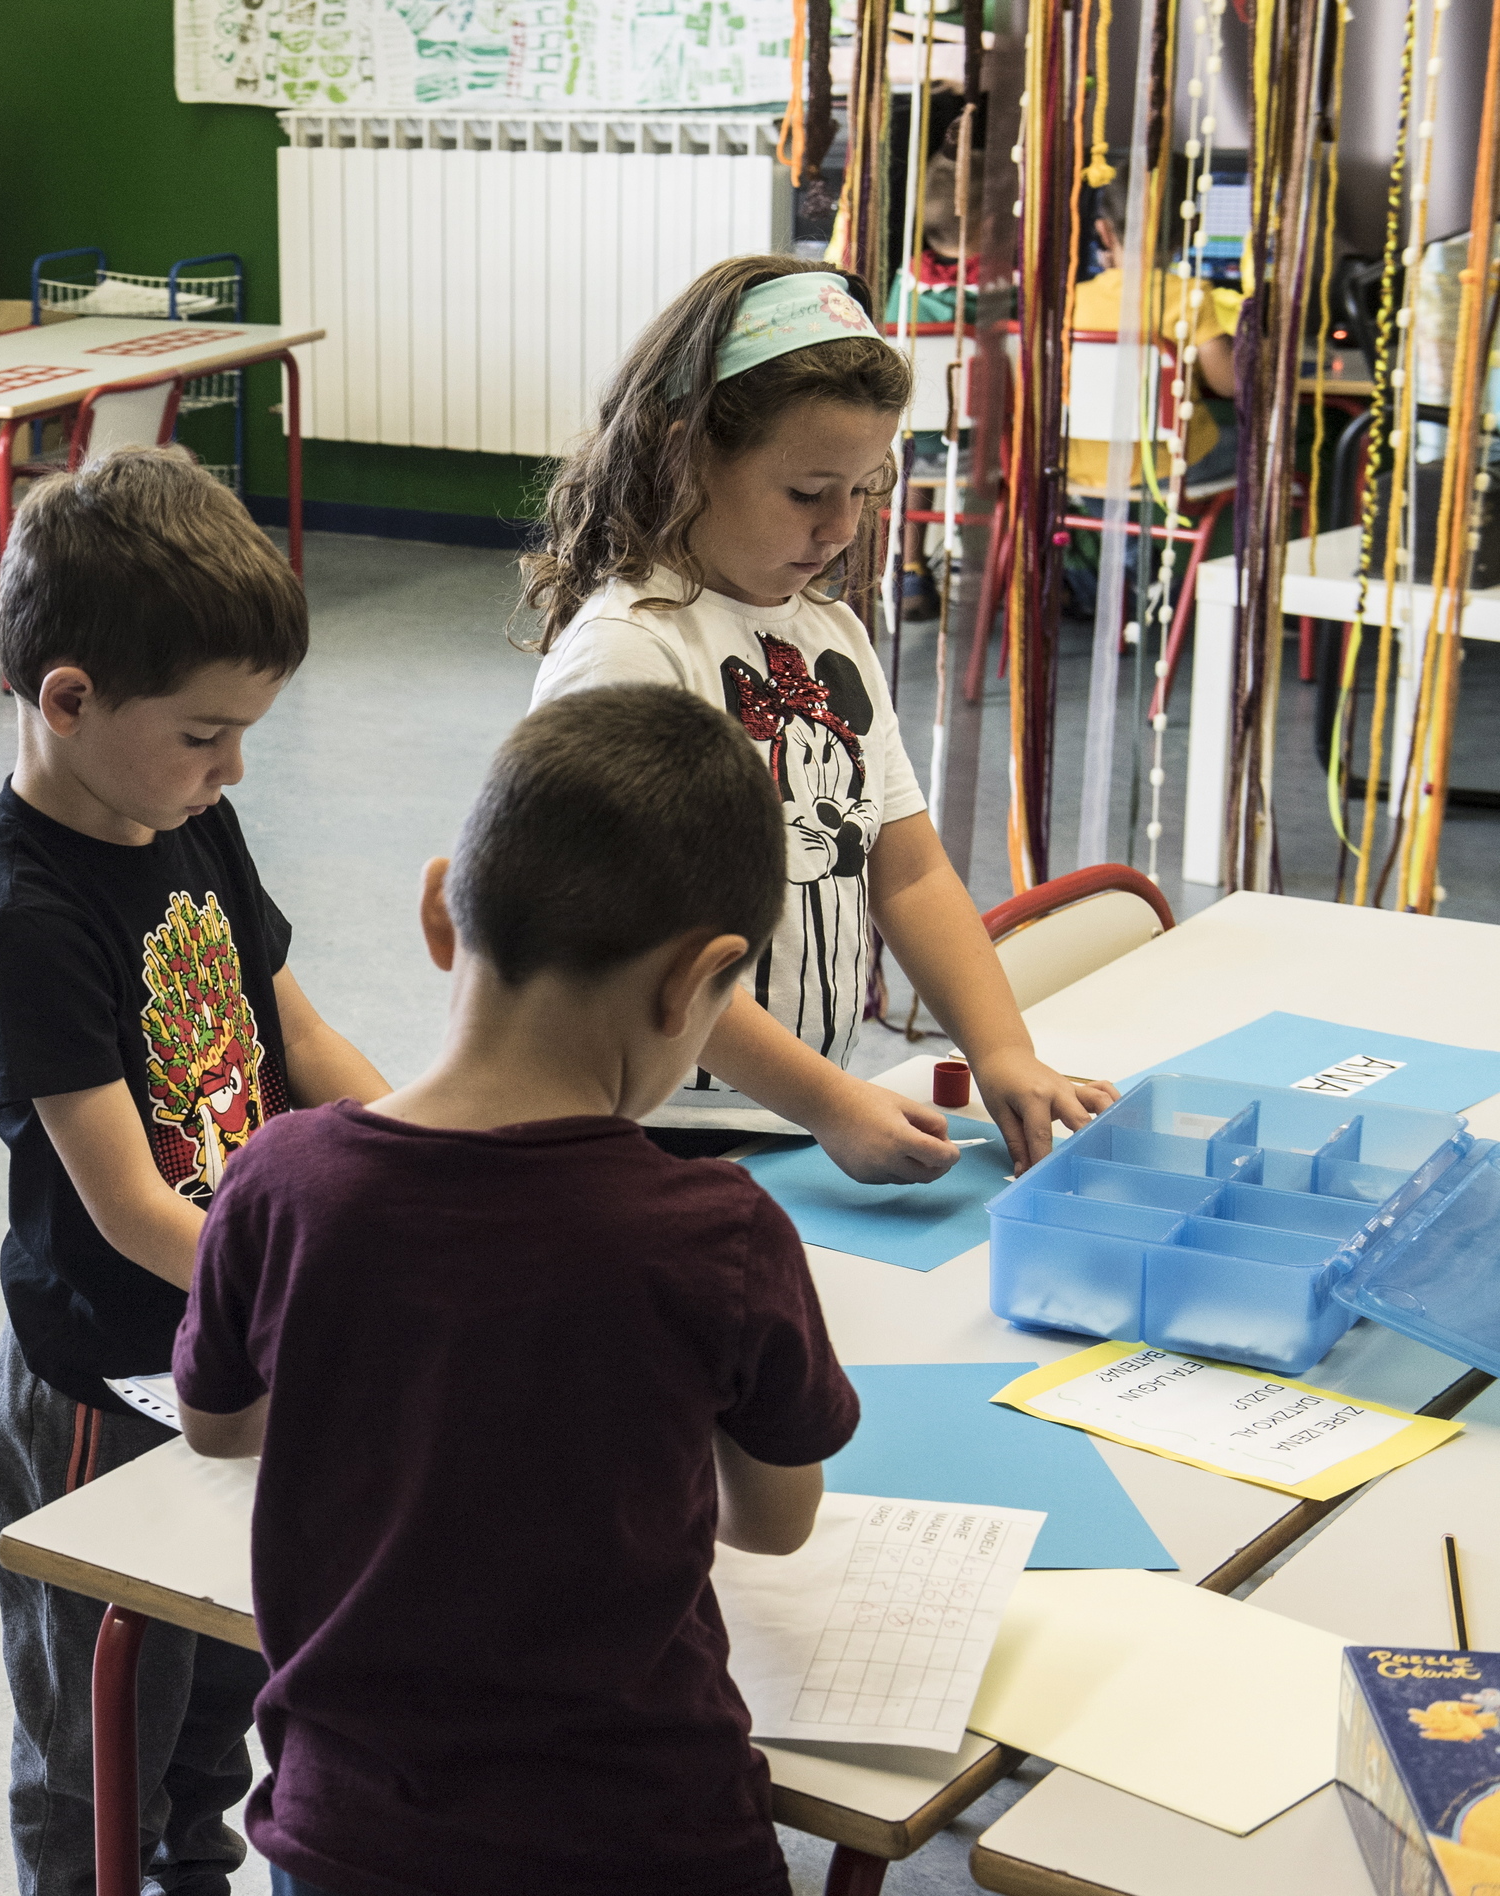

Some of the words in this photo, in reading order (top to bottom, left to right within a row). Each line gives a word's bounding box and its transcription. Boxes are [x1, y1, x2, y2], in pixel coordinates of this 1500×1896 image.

[1297, 1055, 1397, 1092] ANA
[1095, 1349, 1167, 1384] BATENA?
[1229, 1383, 1285, 1411] DUZU?
[1252, 1395, 1325, 1430] IDATZIKO
[1314, 1405, 1365, 1431] ZURE
[1230, 1427, 1258, 1438] AL
[1269, 1428, 1325, 1451] IZENA
[953, 1516, 976, 1541] MARIE
[980, 1520, 1004, 1556] CANDELA
[1368, 1650, 1475, 1667] Puzzle
